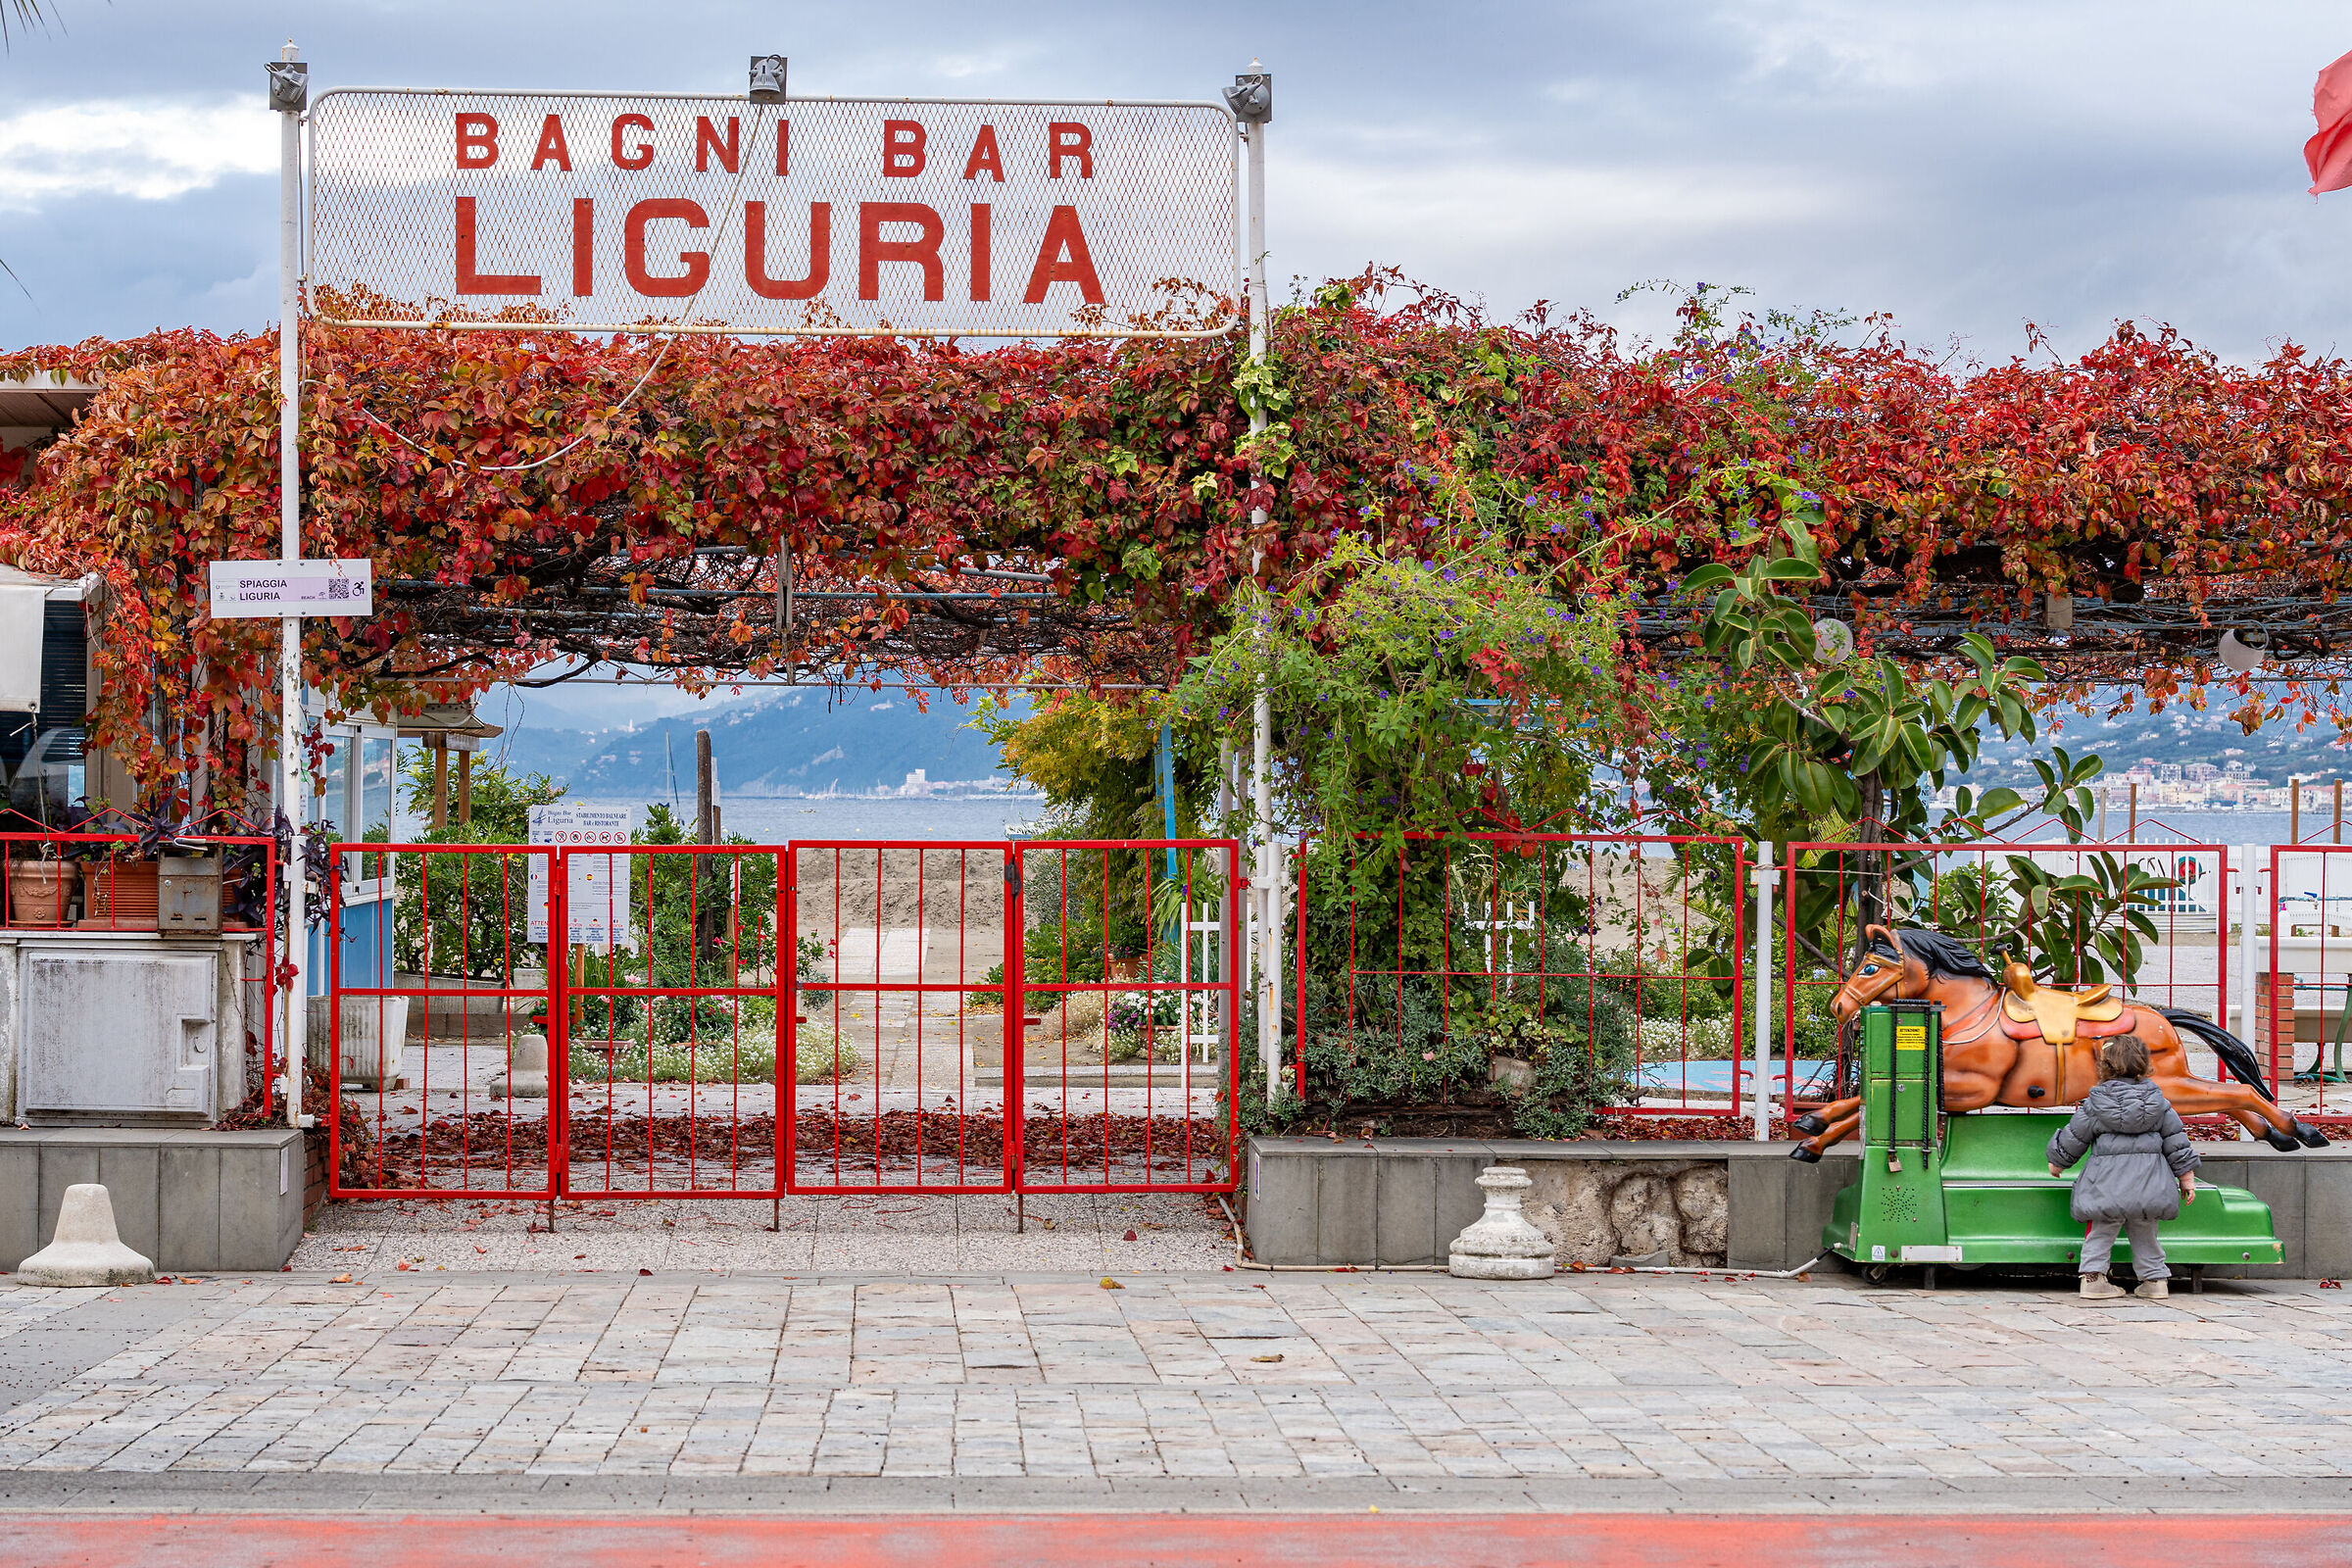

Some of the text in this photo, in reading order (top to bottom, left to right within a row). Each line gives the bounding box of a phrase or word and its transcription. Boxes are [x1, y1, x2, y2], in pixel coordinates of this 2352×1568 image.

[455, 112, 1095, 182] BAGNI BAR
[454, 196, 1106, 305] LIGURIA
[239, 579, 288, 589] SPIAGGIA
[239, 592, 281, 601] LIGURIA
[547, 816, 574, 826] Liguria
